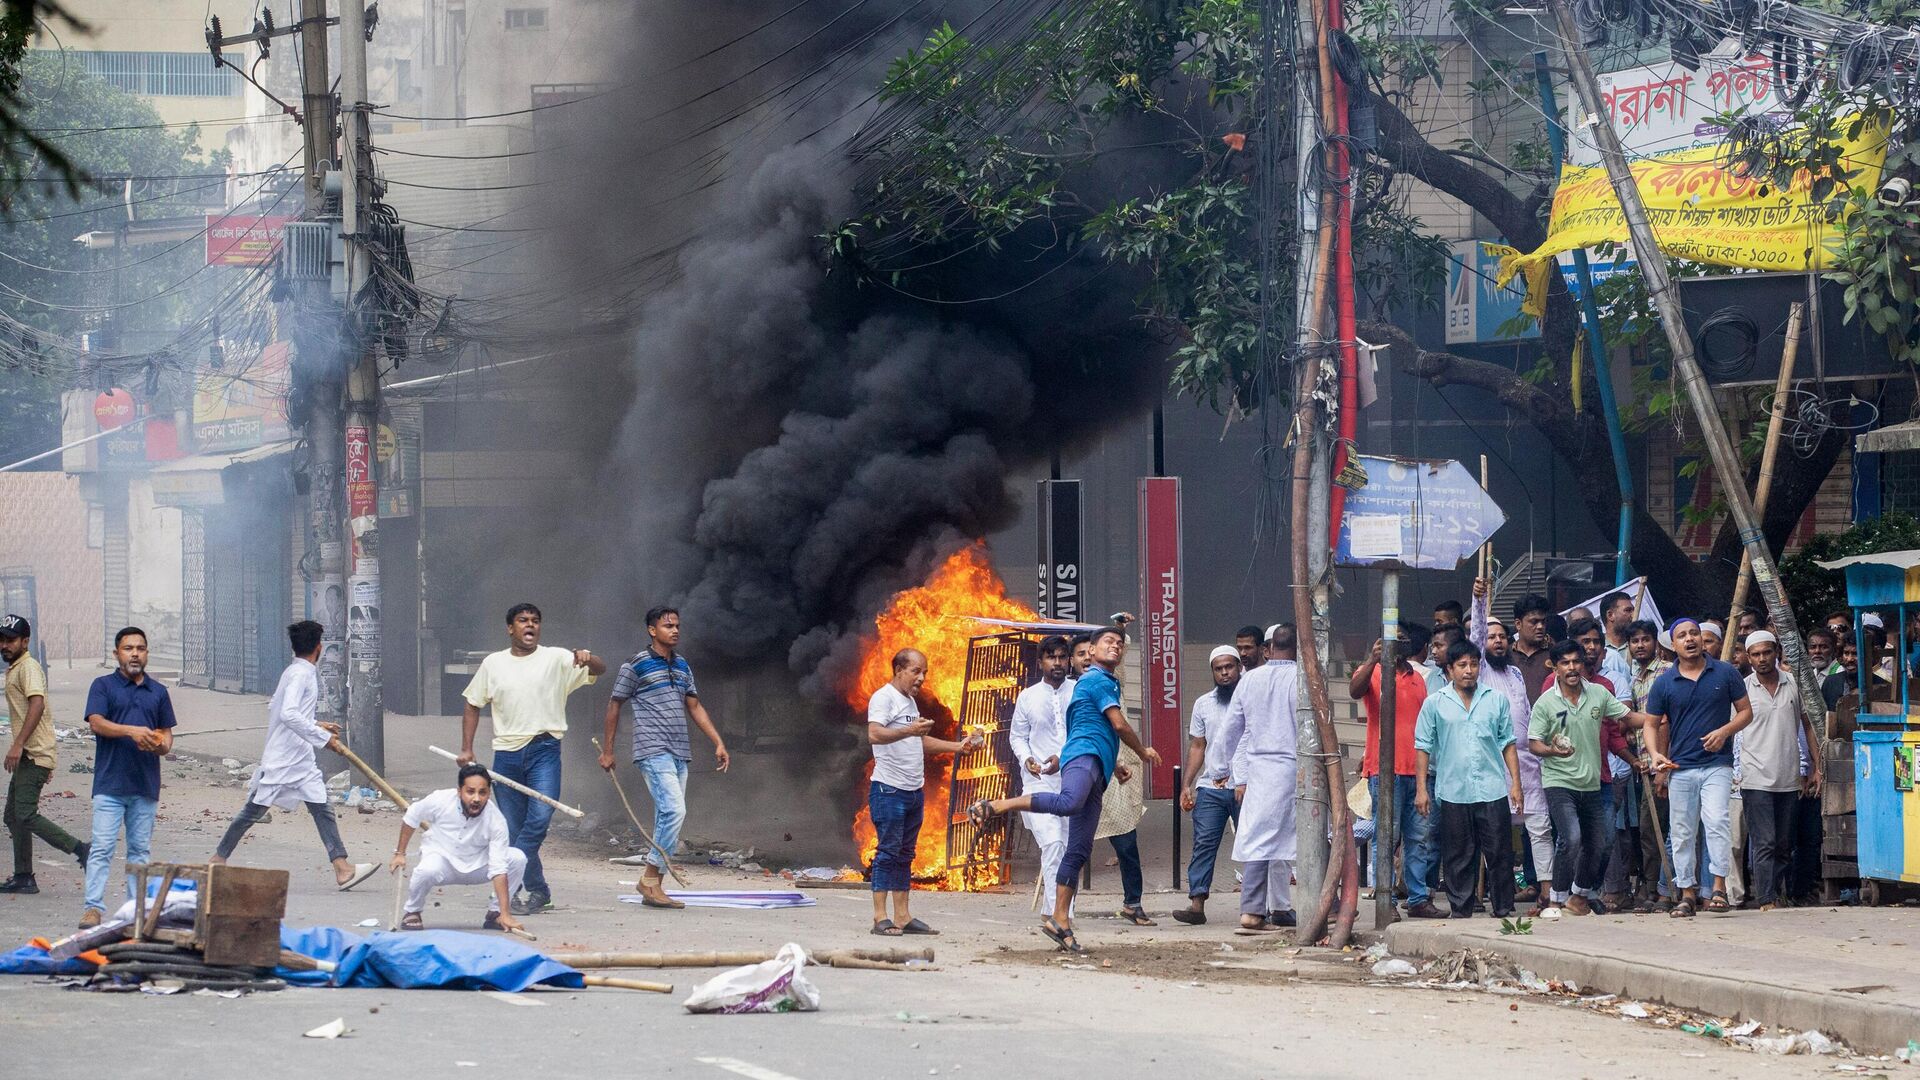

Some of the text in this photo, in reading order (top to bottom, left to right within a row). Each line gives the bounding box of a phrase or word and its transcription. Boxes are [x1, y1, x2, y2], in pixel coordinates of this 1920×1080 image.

[1601, 71, 1694, 130] পরানা
[1675, 199, 1716, 227] শিক্ষা
[1717, 206, 1761, 228] শাখায়
[1763, 197, 1794, 226] ভর্তি
[199, 418, 260, 440] এনাম মটরস
[0, 615, 20, 629] OY
[1151, 612, 1161, 665] DIGITAL
[1162, 567, 1177, 709] TRANSCOM
[1556, 710, 1568, 729] 7
